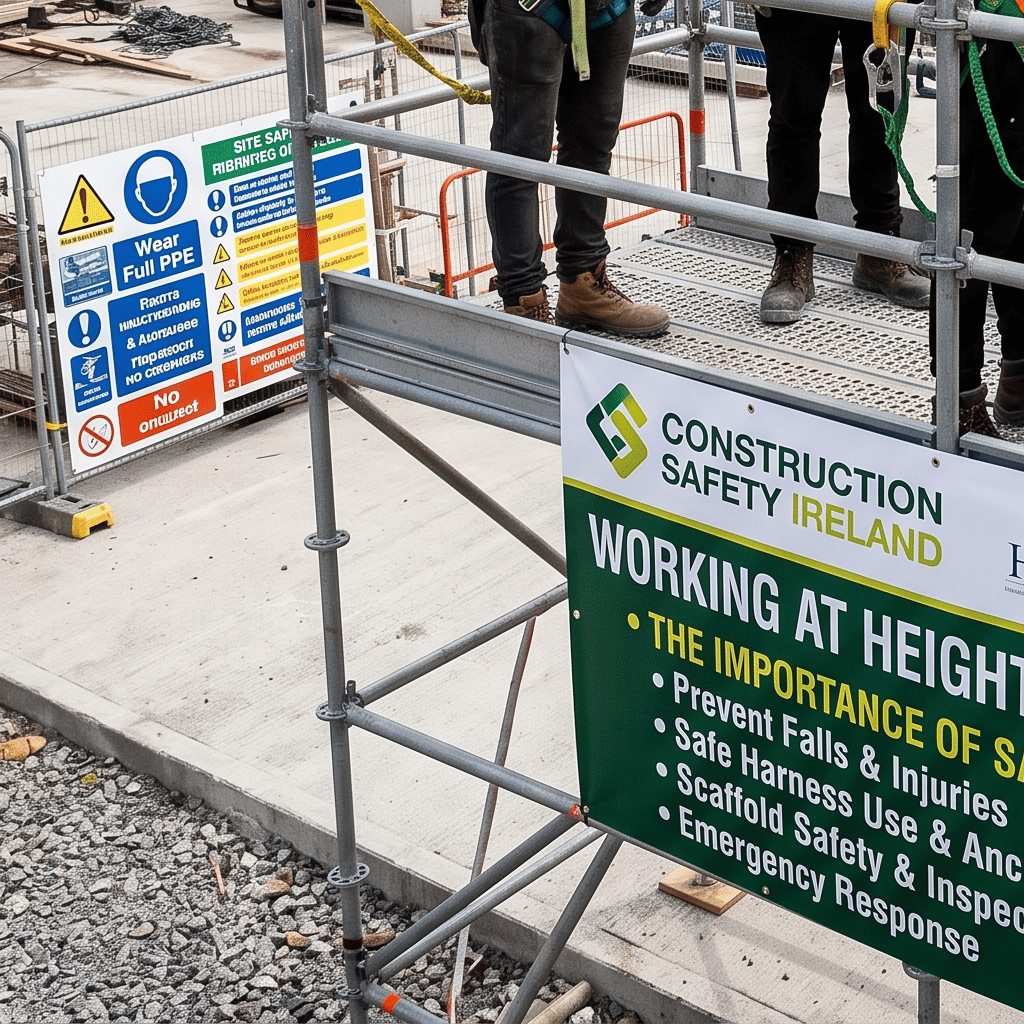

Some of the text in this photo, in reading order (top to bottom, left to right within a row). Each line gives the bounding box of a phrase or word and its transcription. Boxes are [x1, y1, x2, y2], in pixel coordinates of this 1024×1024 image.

[233, 134, 263, 154] SITE
[123, 246, 195, 283] Full PPE
[134, 233, 180, 257] Wear
[661, 412, 943, 526] CONSTRUCTION
[661, 452, 943, 568] SAFETY IRELAND
[587, 512, 781, 635] WORKING
[794, 587, 848, 656] AT
[648, 610, 704, 667] THE
[714, 636, 924, 749] IMPORTANCE
[936, 717, 981, 766] OF
[673, 670, 1009, 828] Prevent Falls & Injuries
[674, 716, 732, 769] Safe
[741, 742, 853, 819] Harness
[863, 792, 918, 844] Use
[930, 819, 952, 857] &
[677, 762, 784, 836] Scaffold
[794, 810, 884, 882] Safety
[894, 853, 916, 892] &
[679, 805, 980, 963] Emergency Response
